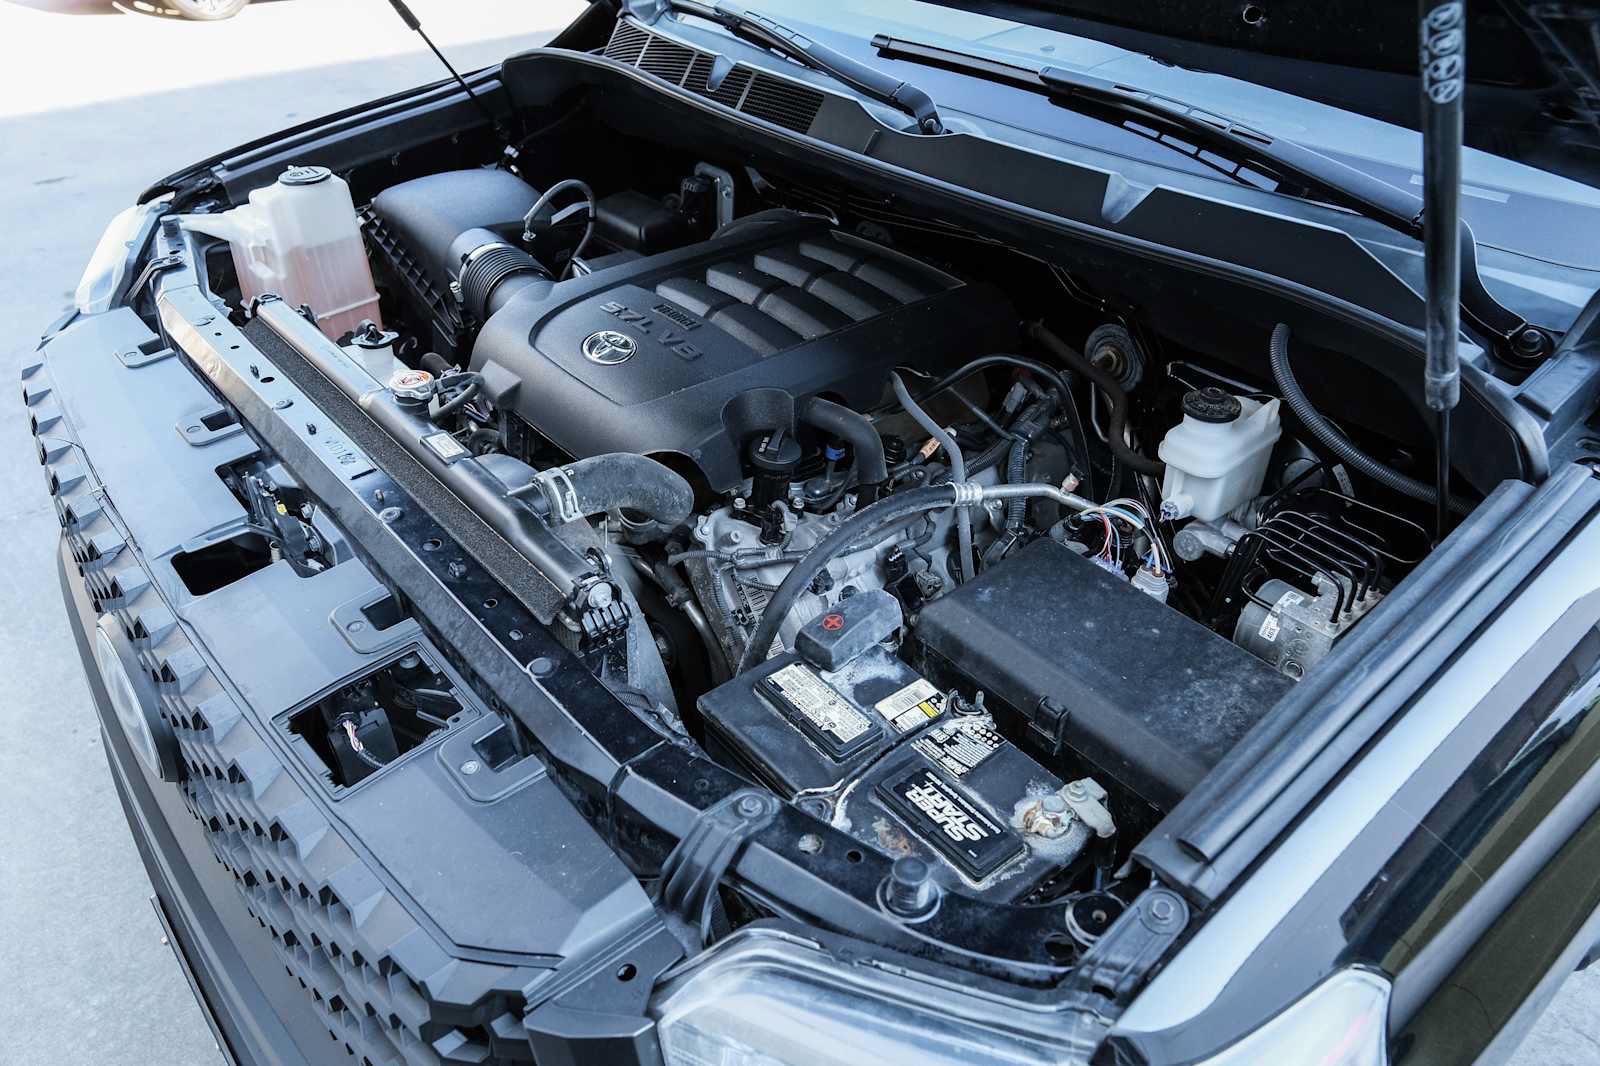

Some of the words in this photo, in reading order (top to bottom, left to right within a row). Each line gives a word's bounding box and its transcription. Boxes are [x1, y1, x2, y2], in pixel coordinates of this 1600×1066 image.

[657, 329, 703, 361] V8
[905, 788, 964, 841] SUPER
[912, 782, 989, 841] START
